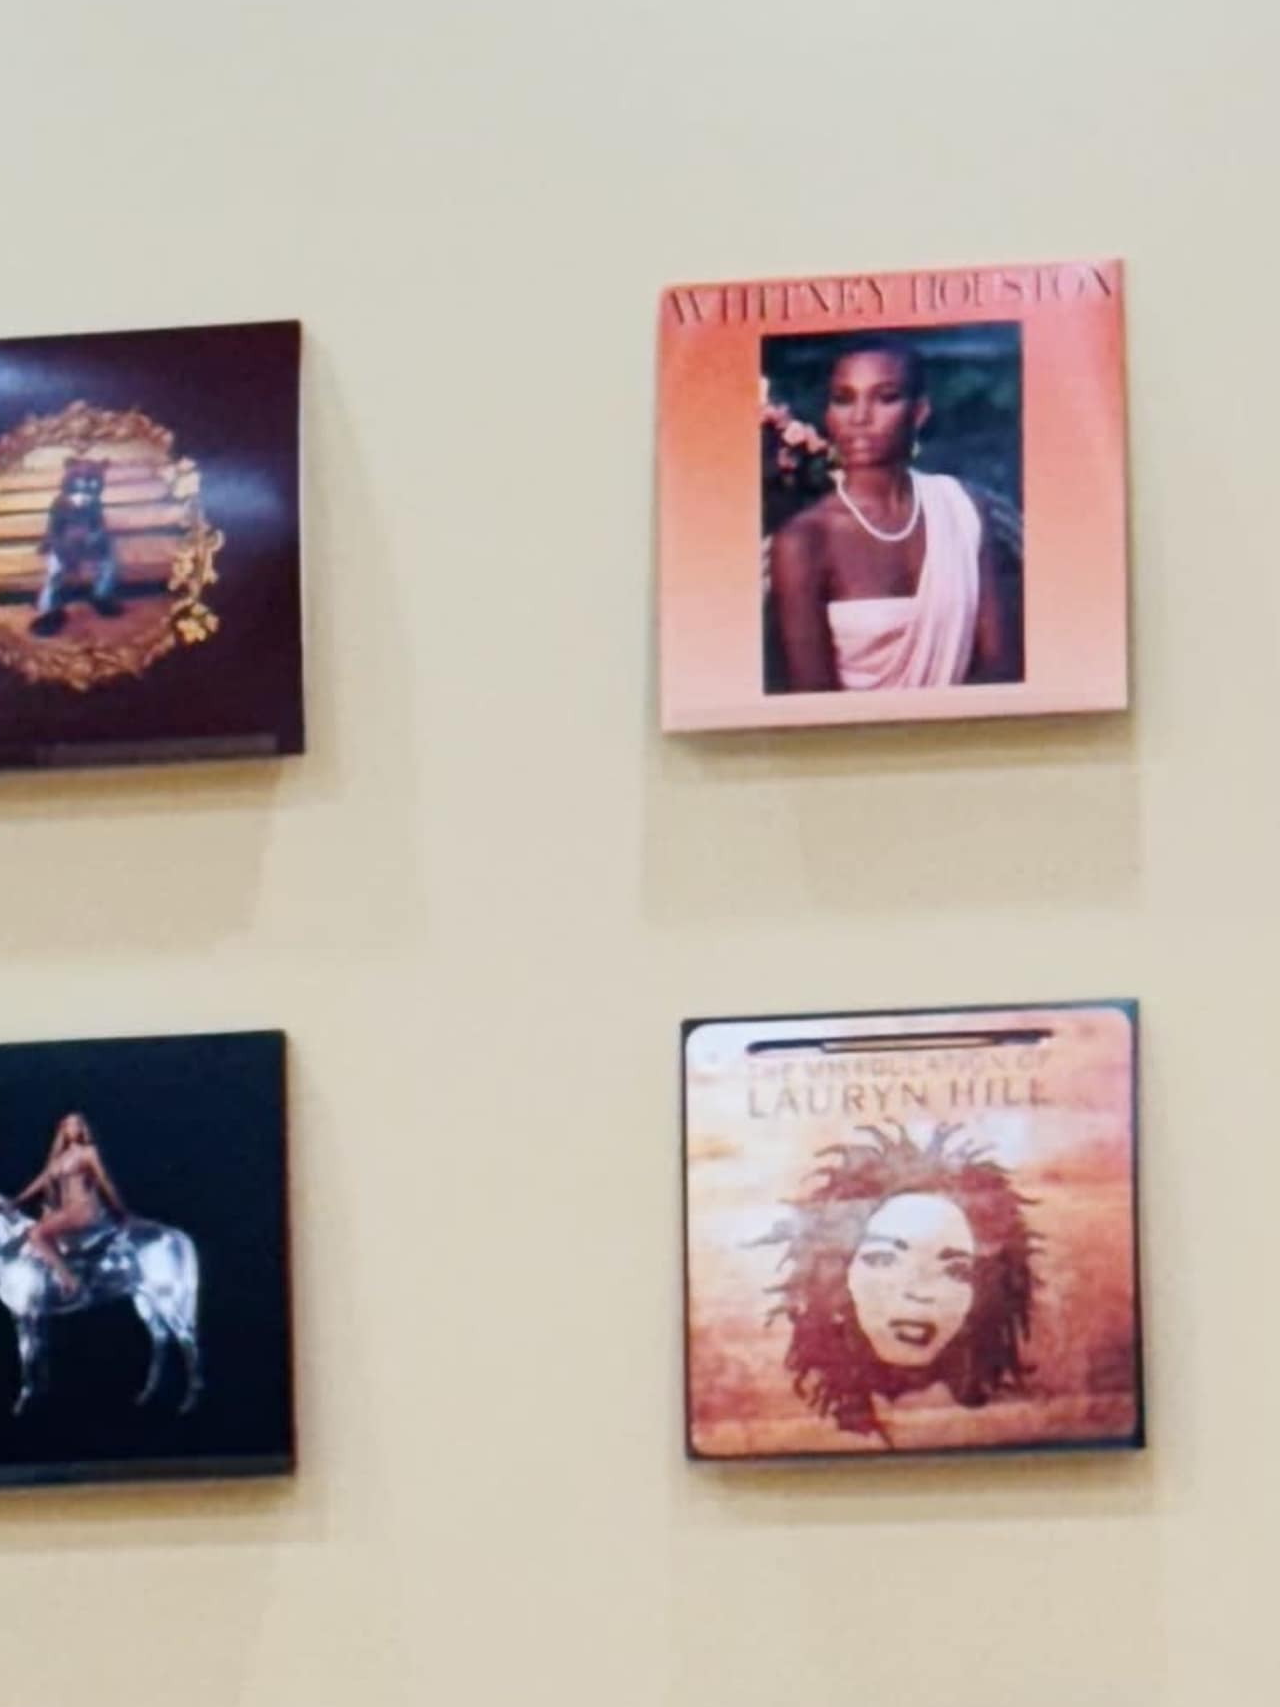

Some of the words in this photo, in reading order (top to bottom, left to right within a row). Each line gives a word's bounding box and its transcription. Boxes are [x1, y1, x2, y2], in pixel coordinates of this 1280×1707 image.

[668, 277, 887, 325] WHITNEY
[909, 266, 1113, 314] HOUSTON
[748, 1080, 928, 1119] LAURYN
[950, 1076, 1056, 1107] HILL
